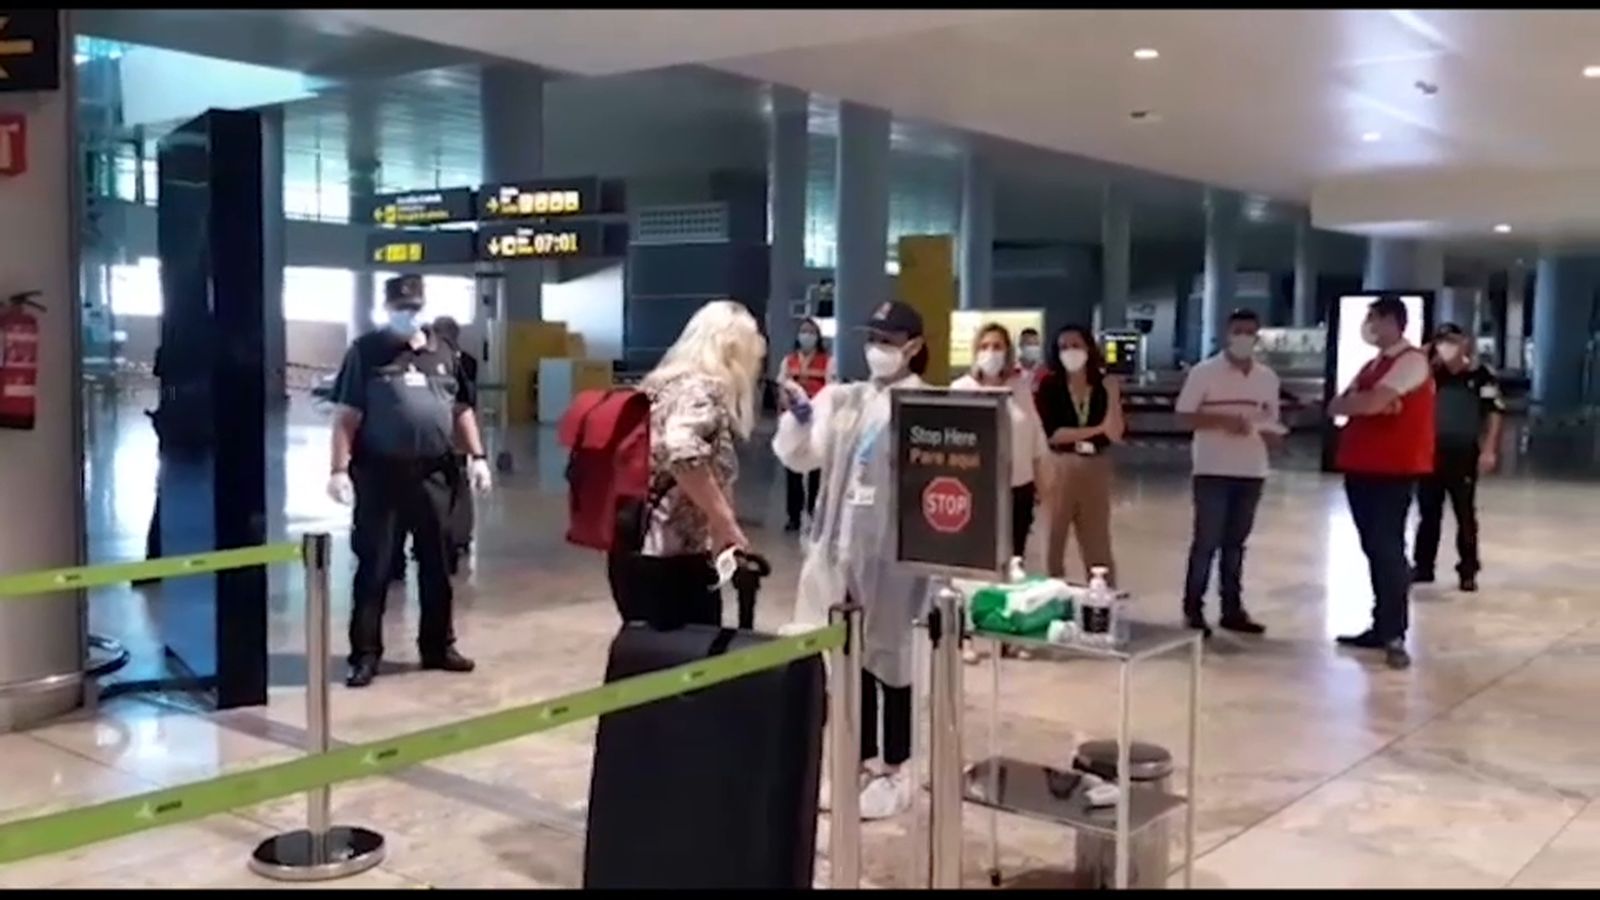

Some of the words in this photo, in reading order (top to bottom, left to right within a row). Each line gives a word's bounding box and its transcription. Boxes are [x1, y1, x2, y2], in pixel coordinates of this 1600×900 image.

[534, 231, 577, 253] 07:01
[910, 425, 942, 446] Stop
[944, 428, 977, 446] Here
[926, 492, 968, 515] STOP
